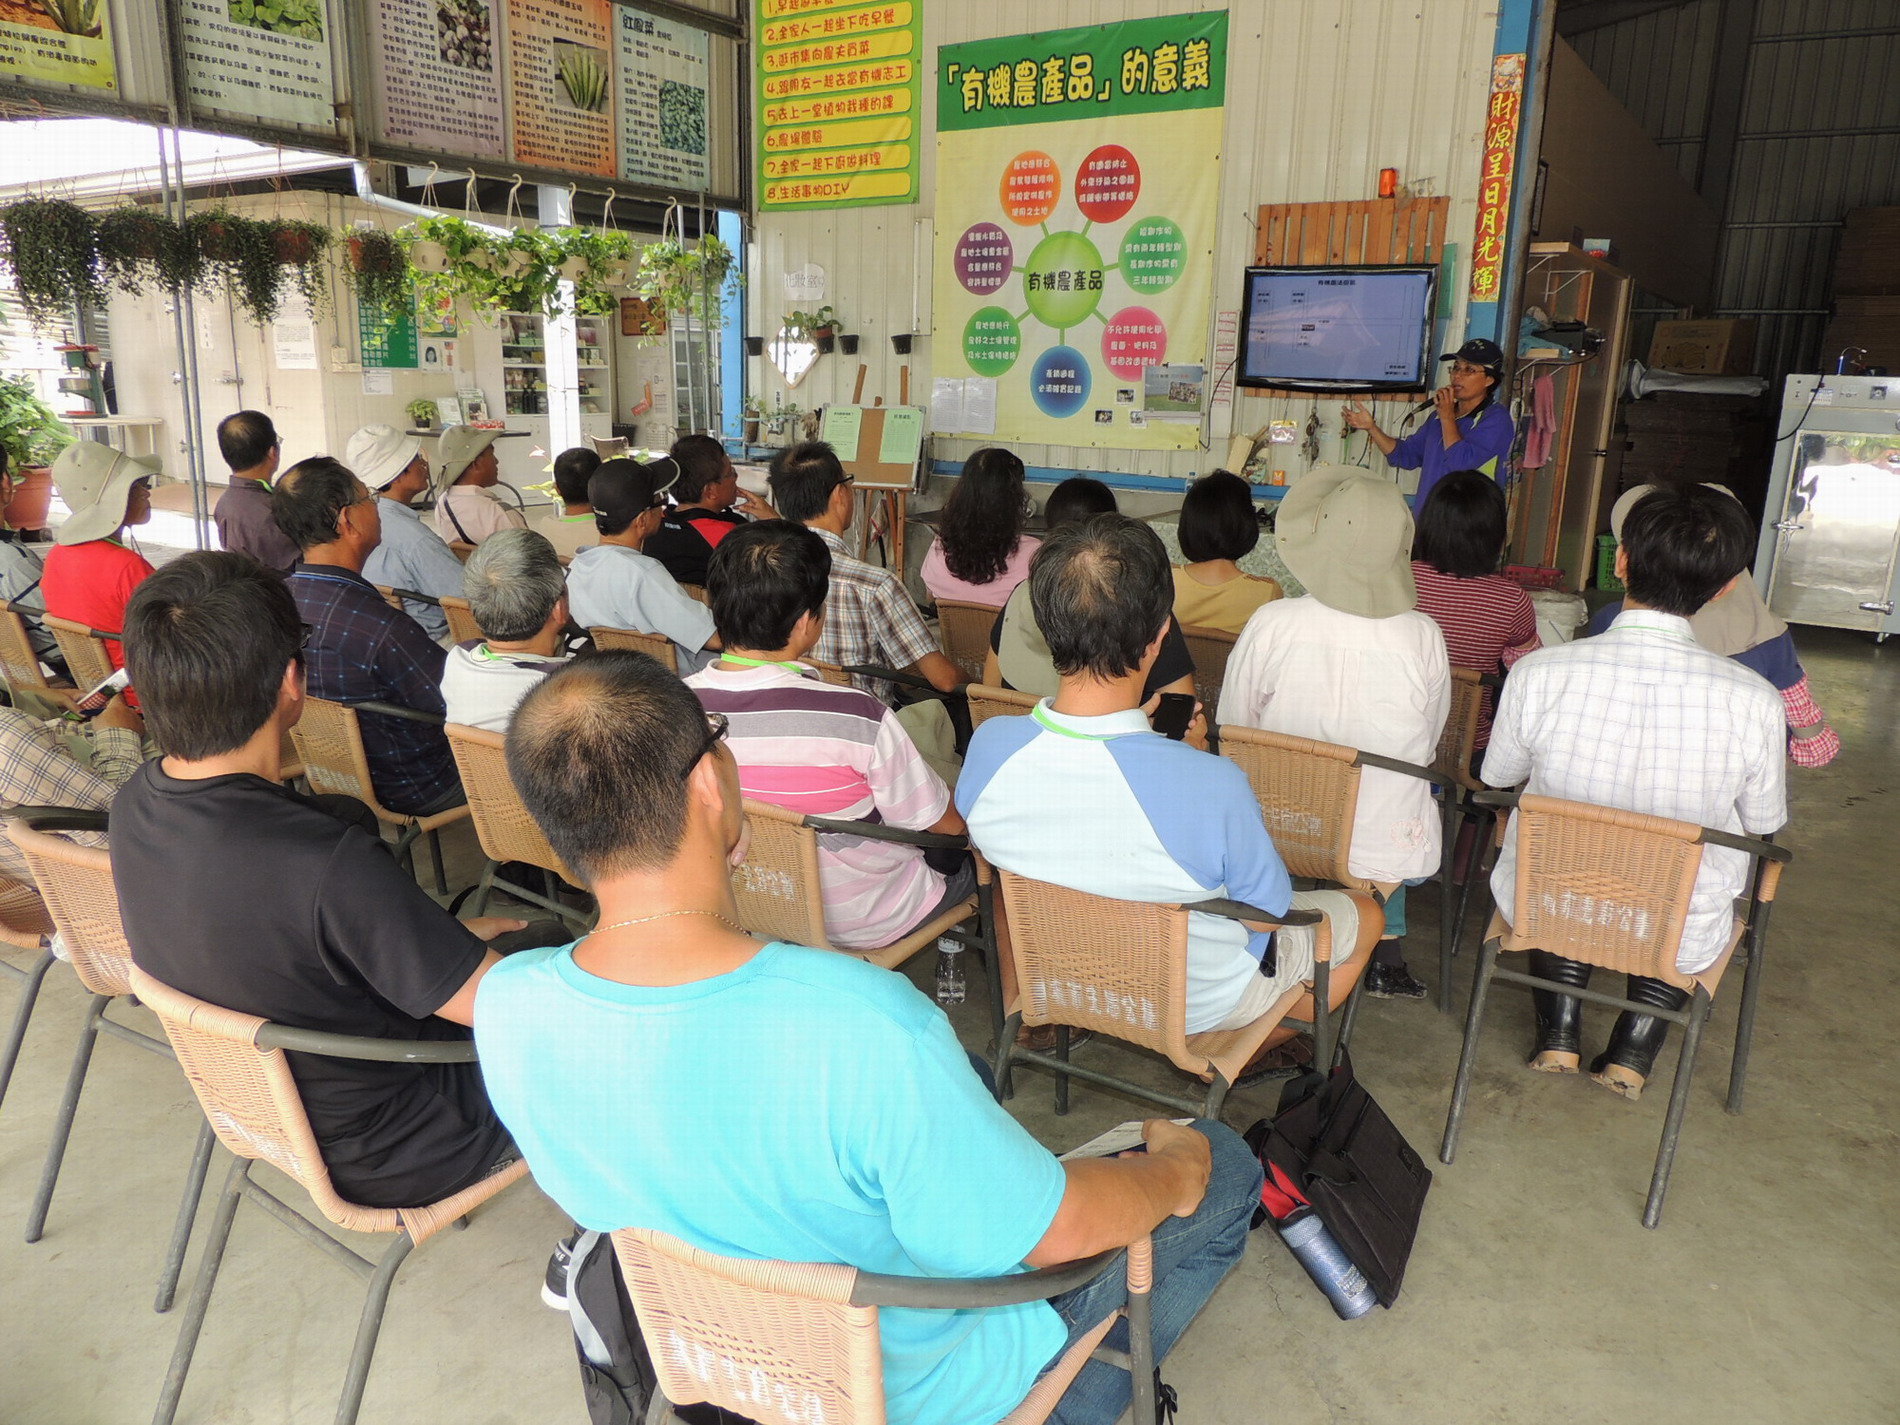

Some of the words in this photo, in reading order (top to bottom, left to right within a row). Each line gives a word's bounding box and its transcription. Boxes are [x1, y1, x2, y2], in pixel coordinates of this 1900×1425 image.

[766, 8, 895, 41] 2.全家人一起坐下吃早餐
[948, 39, 1210, 112] 「有機農產品」的意義
[767, 94, 894, 122] 5.去上一堂植物栽種的課
[767, 129, 823, 148] 6.農場體驗
[1028, 270, 1103, 291] 有機農產品
